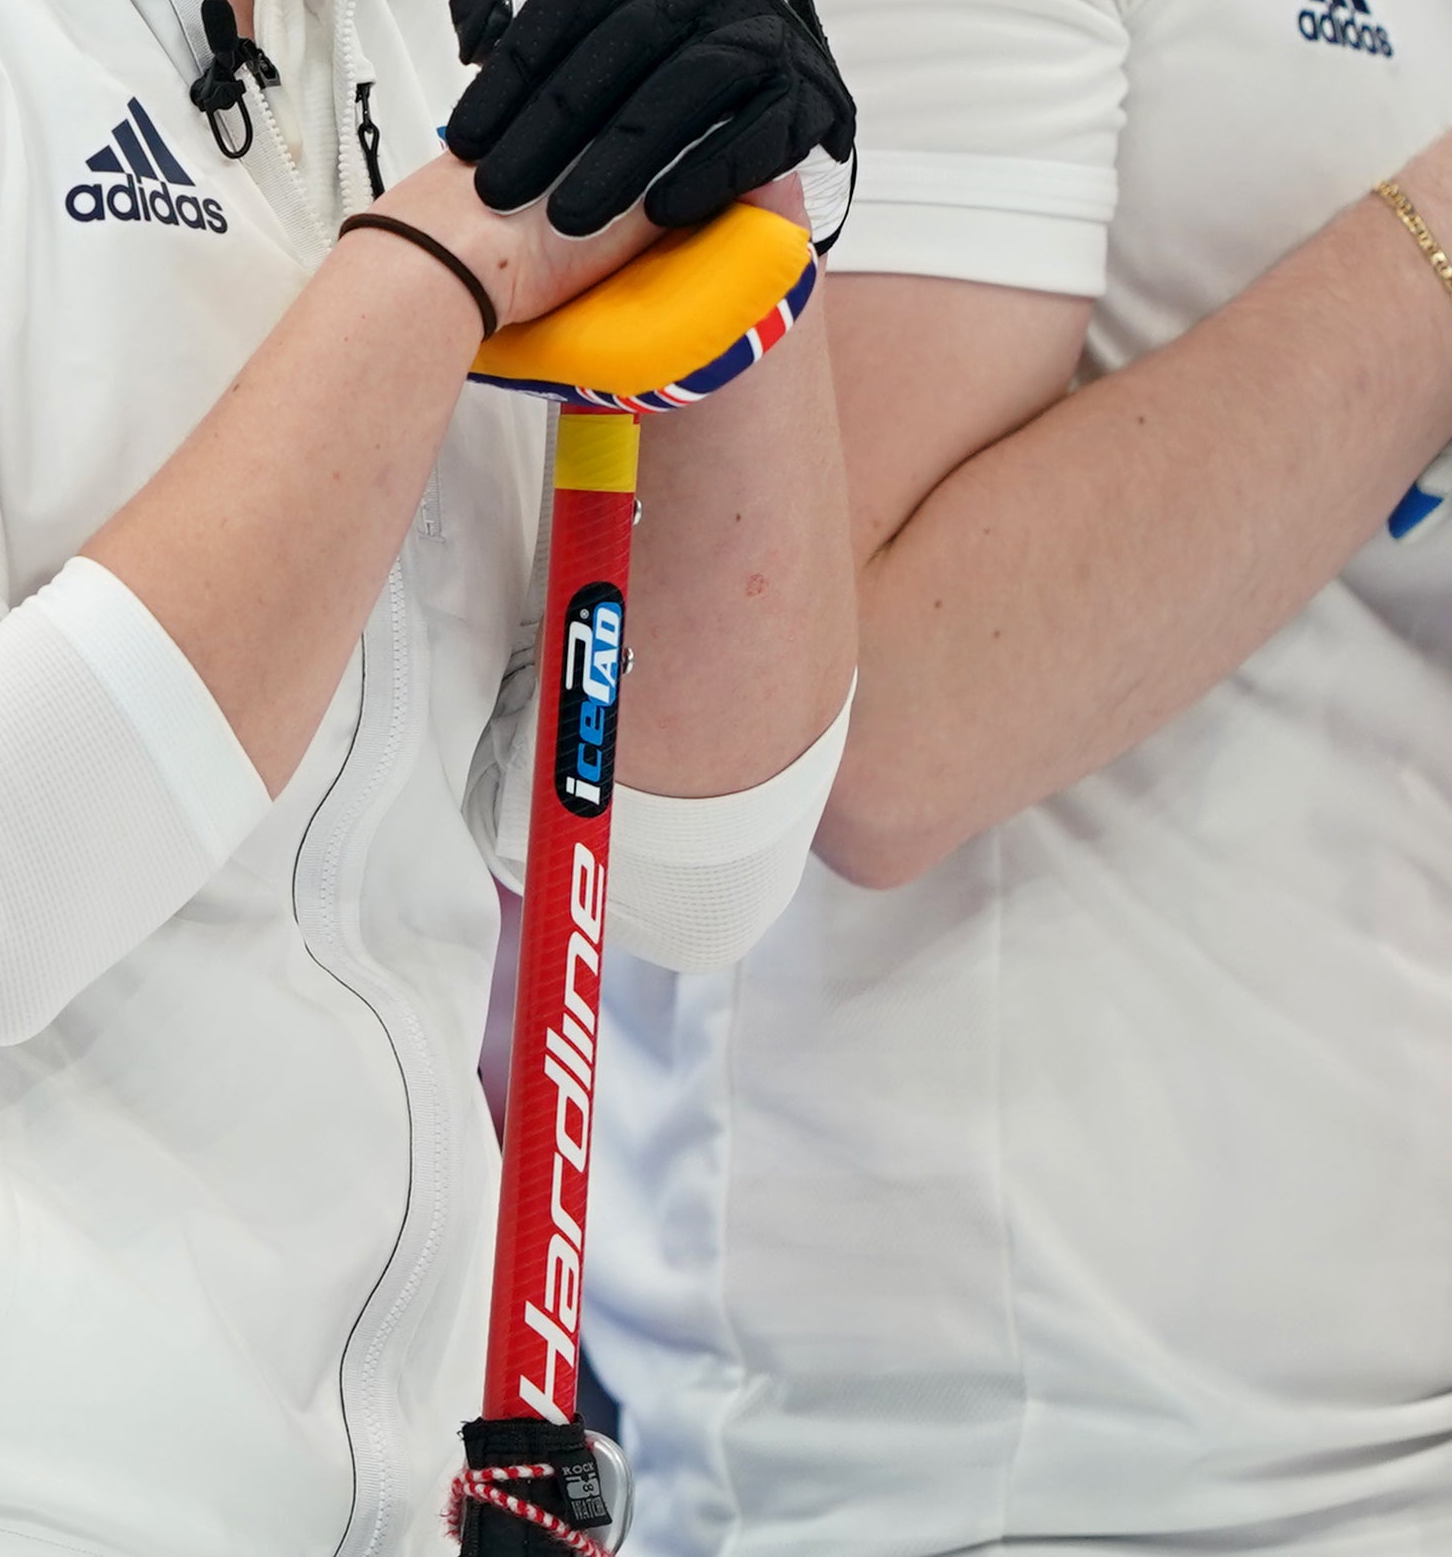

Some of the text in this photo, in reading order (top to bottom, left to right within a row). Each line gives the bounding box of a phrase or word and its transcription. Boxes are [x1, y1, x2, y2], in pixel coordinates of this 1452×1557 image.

[1298, 5, 1392, 58] adidas
[65, 173, 229, 235] adidas
[519, 842, 604, 1426] Hardline
[562, 1462, 595, 1476] ROCK
